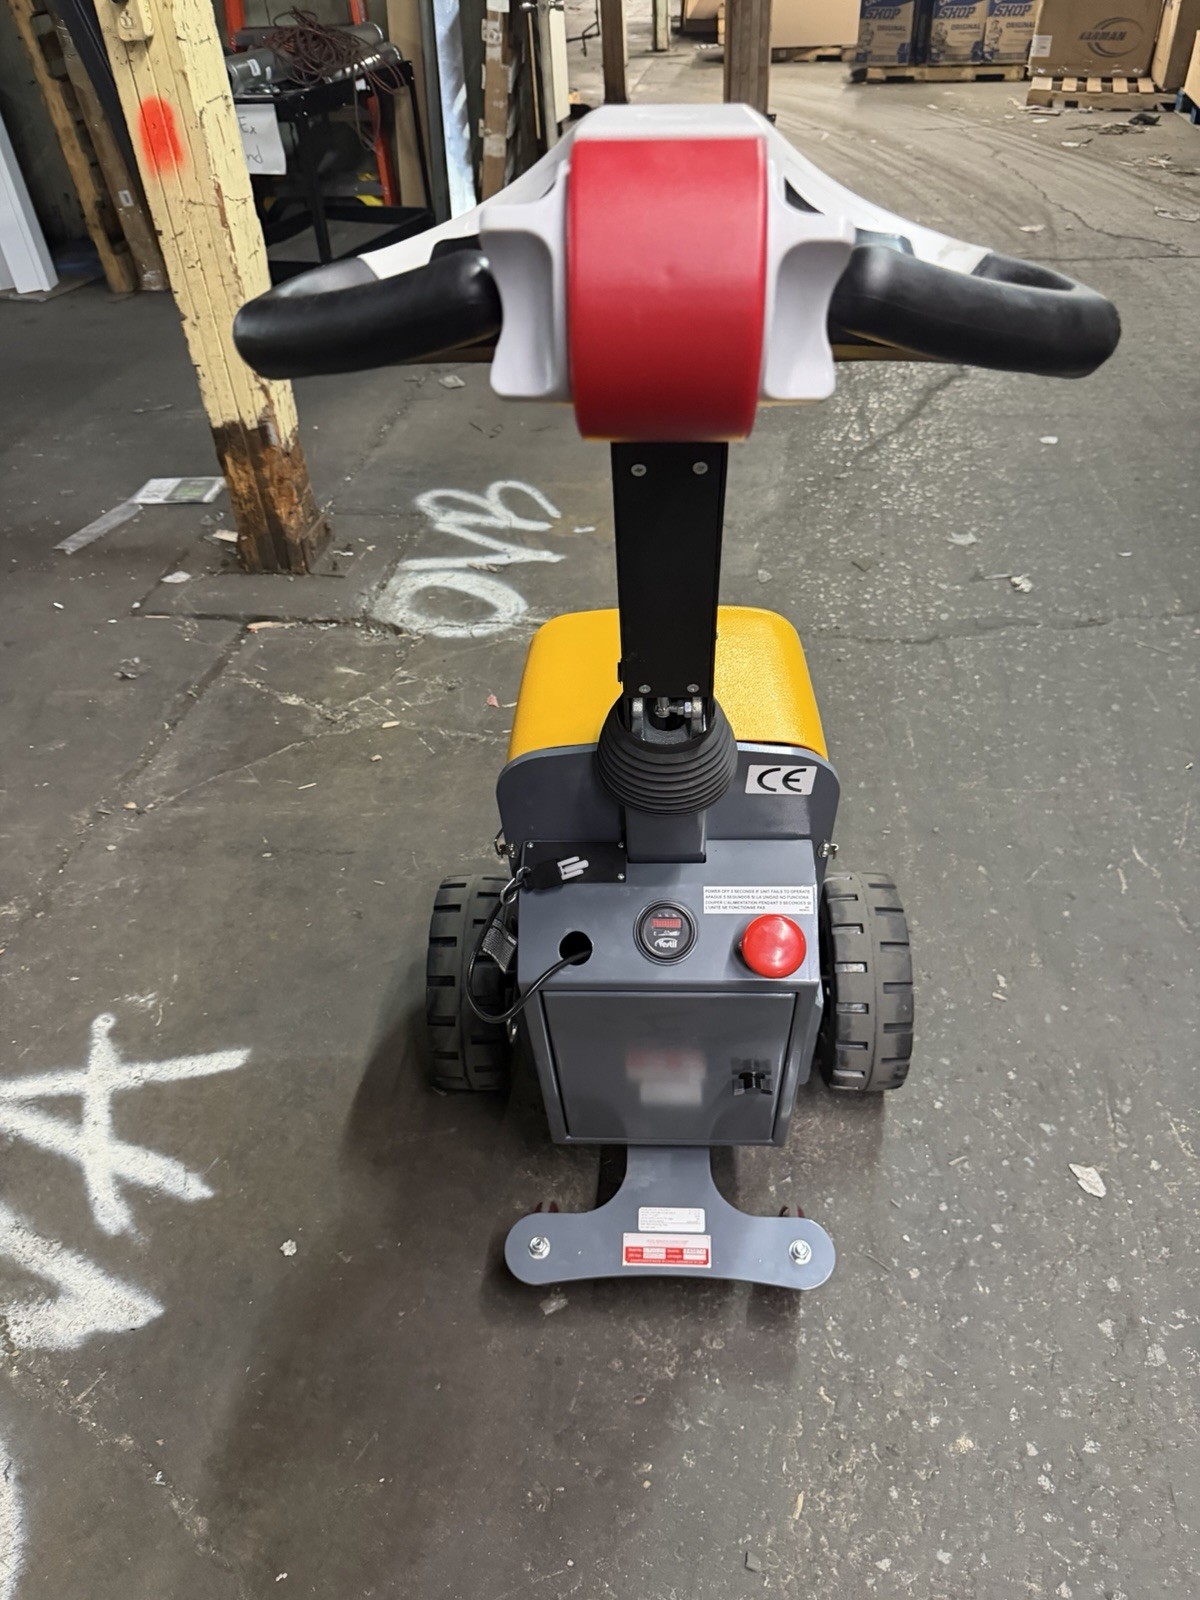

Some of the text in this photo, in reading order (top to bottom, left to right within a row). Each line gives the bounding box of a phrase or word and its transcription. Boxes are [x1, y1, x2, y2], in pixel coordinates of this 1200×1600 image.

[865, 8, 902, 20] SHOP
[938, 6, 976, 19] SHOP
[993, 4, 1032, 17] SHOP
[757, 767, 807, 793] CE
